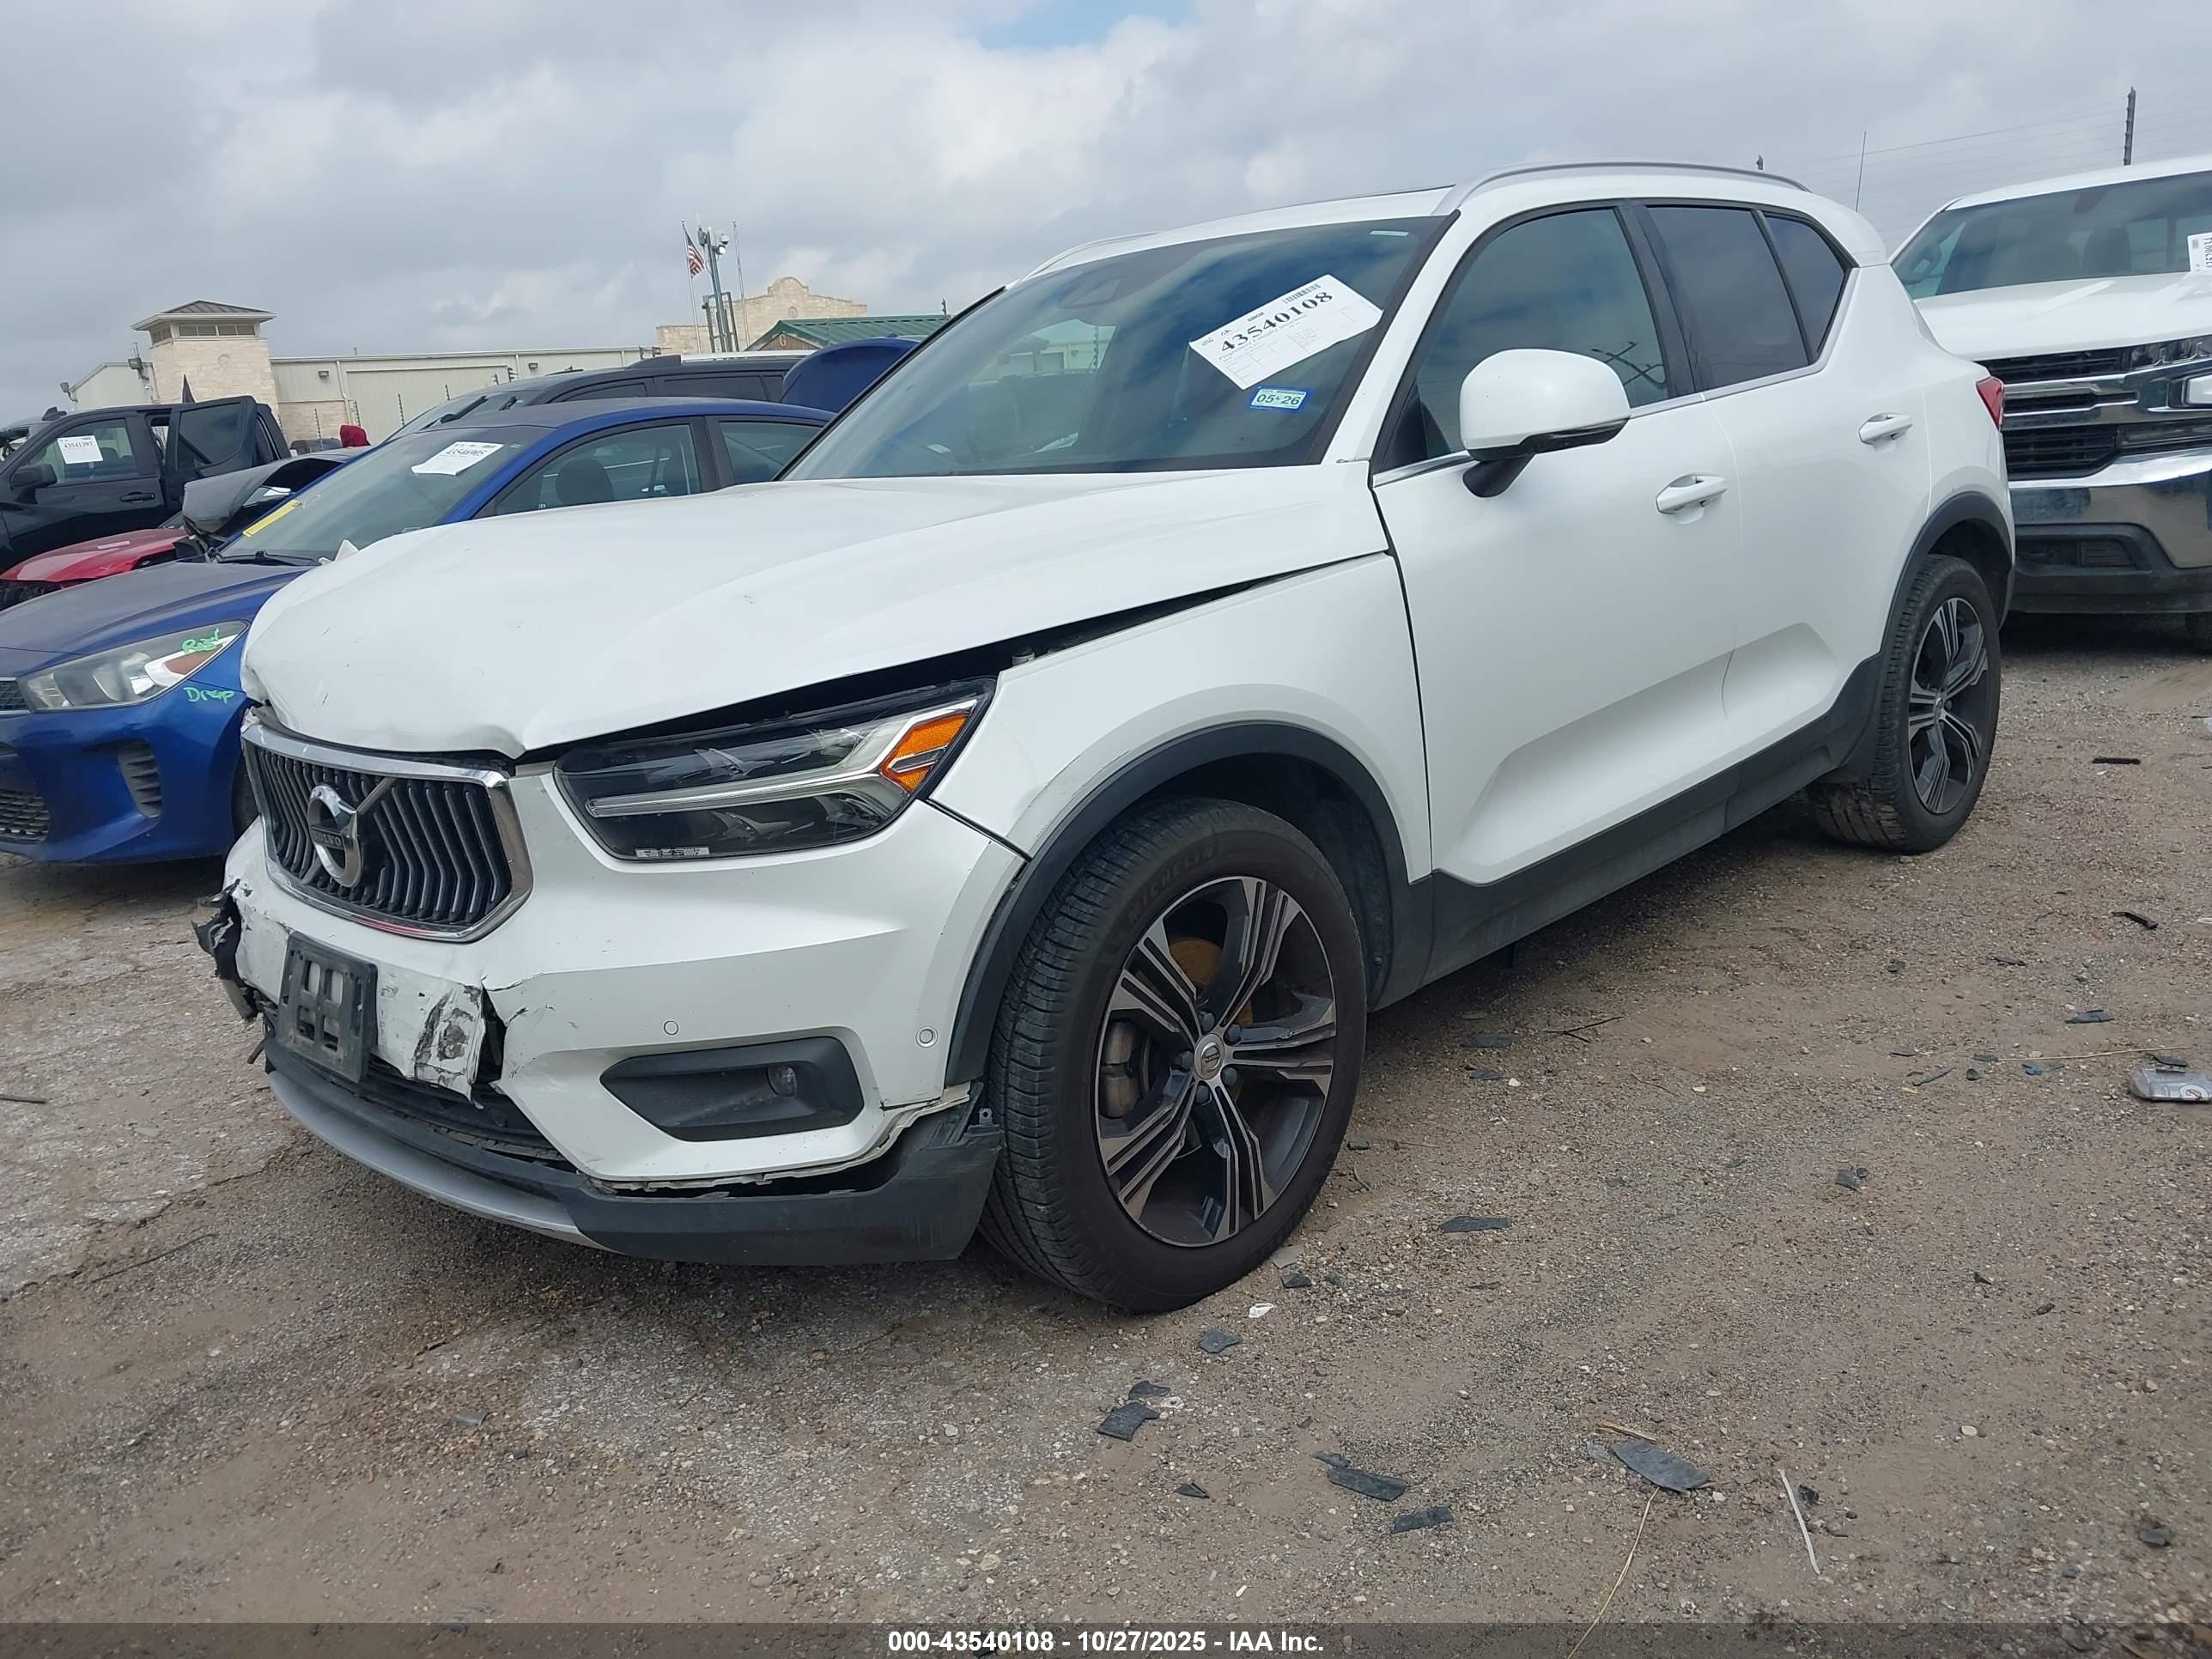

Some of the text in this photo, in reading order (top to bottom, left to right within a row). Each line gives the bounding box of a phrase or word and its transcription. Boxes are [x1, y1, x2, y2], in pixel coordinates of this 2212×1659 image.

[1220, 291, 1334, 353] 43540108
[1256, 394, 1301, 405] 05 26
[312, 830, 342, 847] VOLVO
